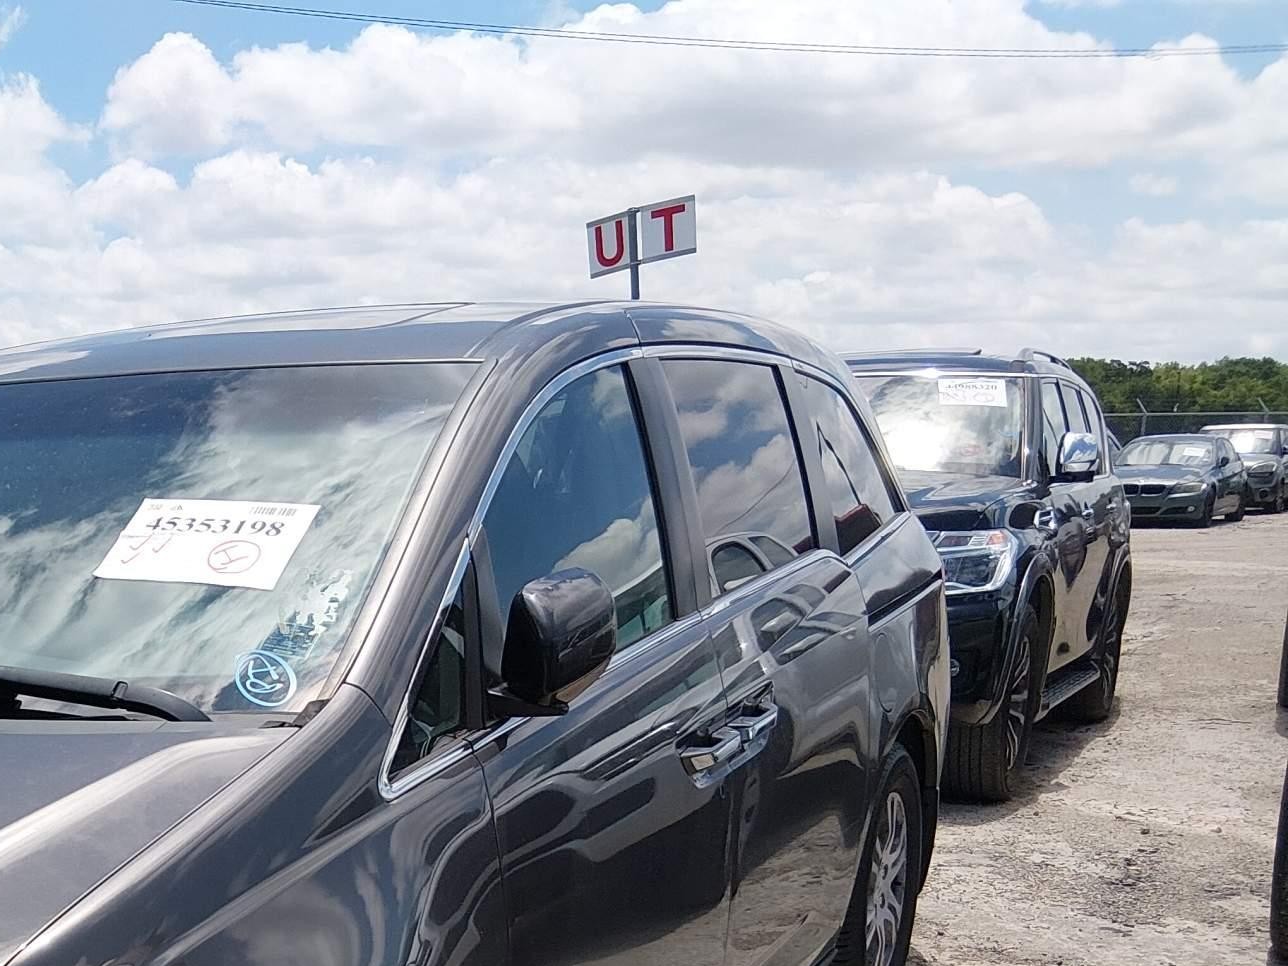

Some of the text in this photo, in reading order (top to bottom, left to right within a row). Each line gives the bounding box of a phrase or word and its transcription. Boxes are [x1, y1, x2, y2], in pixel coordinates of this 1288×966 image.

[595, 204, 685, 267] U T
[146, 516, 285, 537] 45353198
